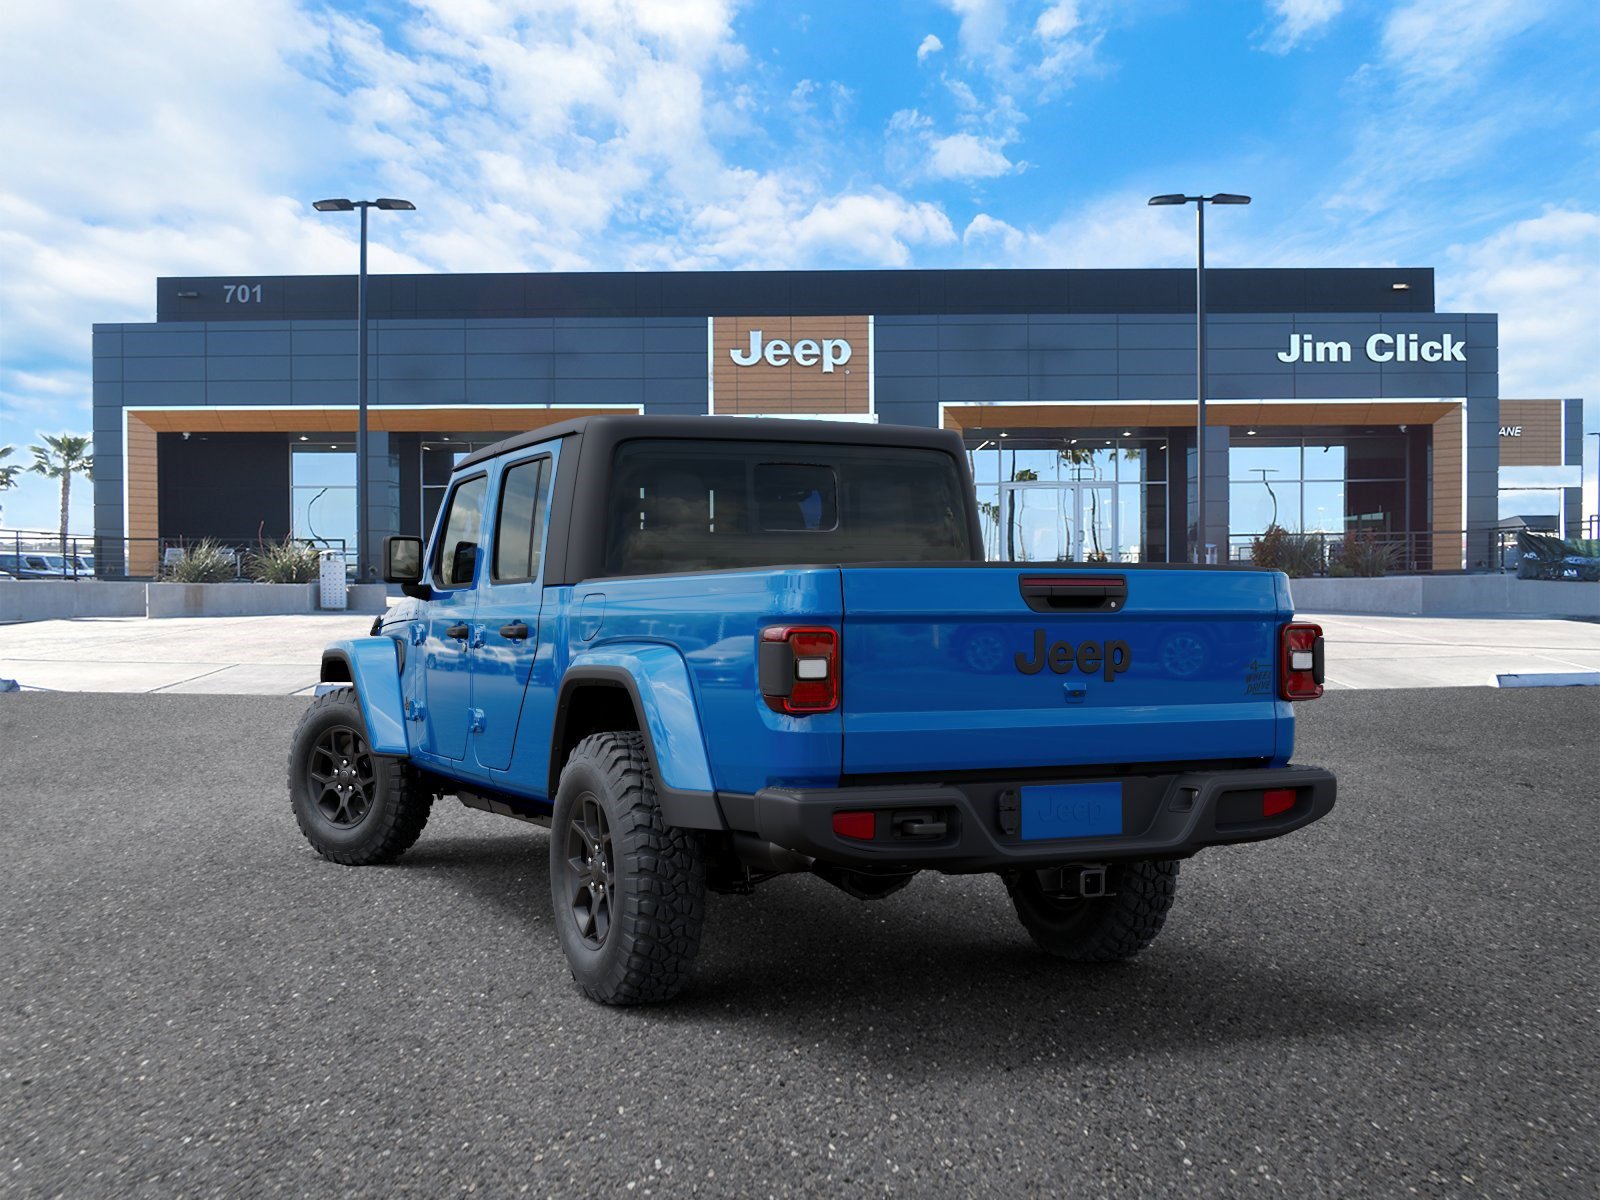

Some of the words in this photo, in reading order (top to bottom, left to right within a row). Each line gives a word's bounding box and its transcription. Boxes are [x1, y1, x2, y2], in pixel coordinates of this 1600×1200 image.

[223, 284, 262, 304] 701
[729, 330, 852, 373] Jeep
[1277, 333, 1351, 363] Jim
[1365, 333, 1467, 363] Click
[1015, 629, 1132, 682] Jeep
[1037, 793, 1104, 825] Jeep
